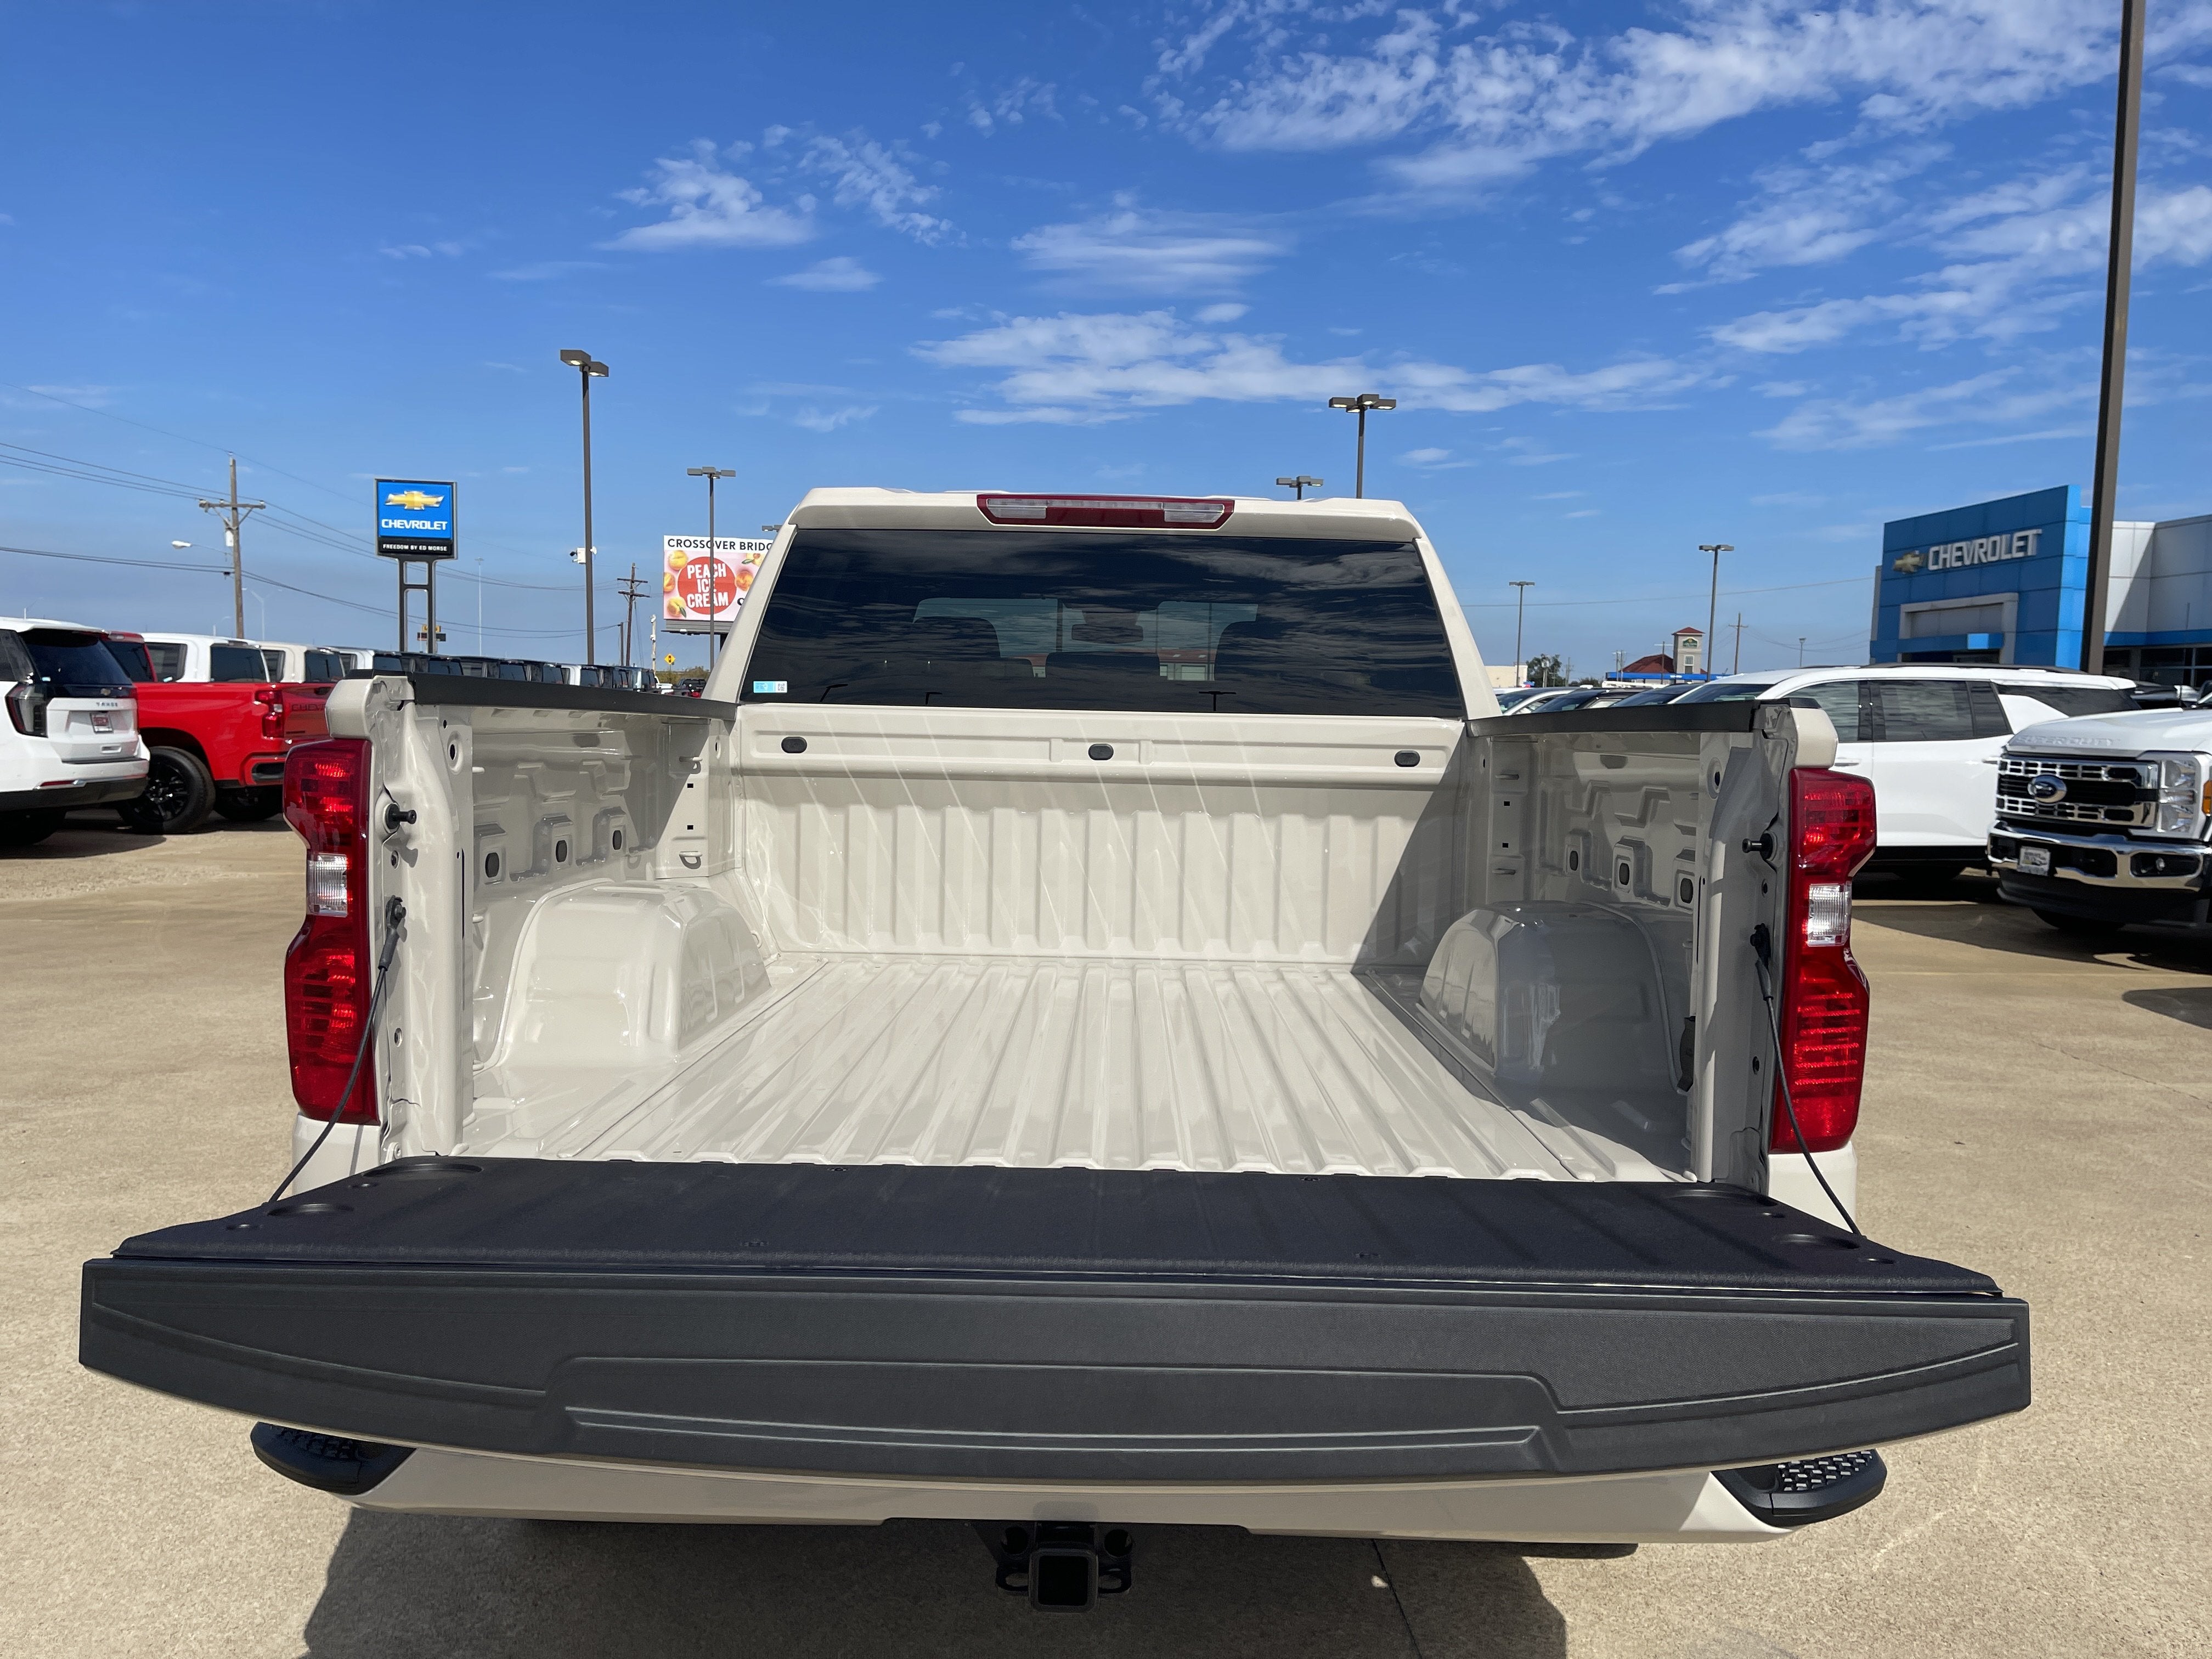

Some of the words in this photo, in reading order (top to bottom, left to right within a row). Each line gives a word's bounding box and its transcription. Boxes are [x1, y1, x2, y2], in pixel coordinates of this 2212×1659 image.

[381, 518, 448, 531] CHEVROLET
[668, 538, 736, 550] CROSSOVER
[1928, 528, 2042, 571] CHEVROLET
[687, 563, 727, 579] PEACH
[686, 591, 729, 608] CREAM
